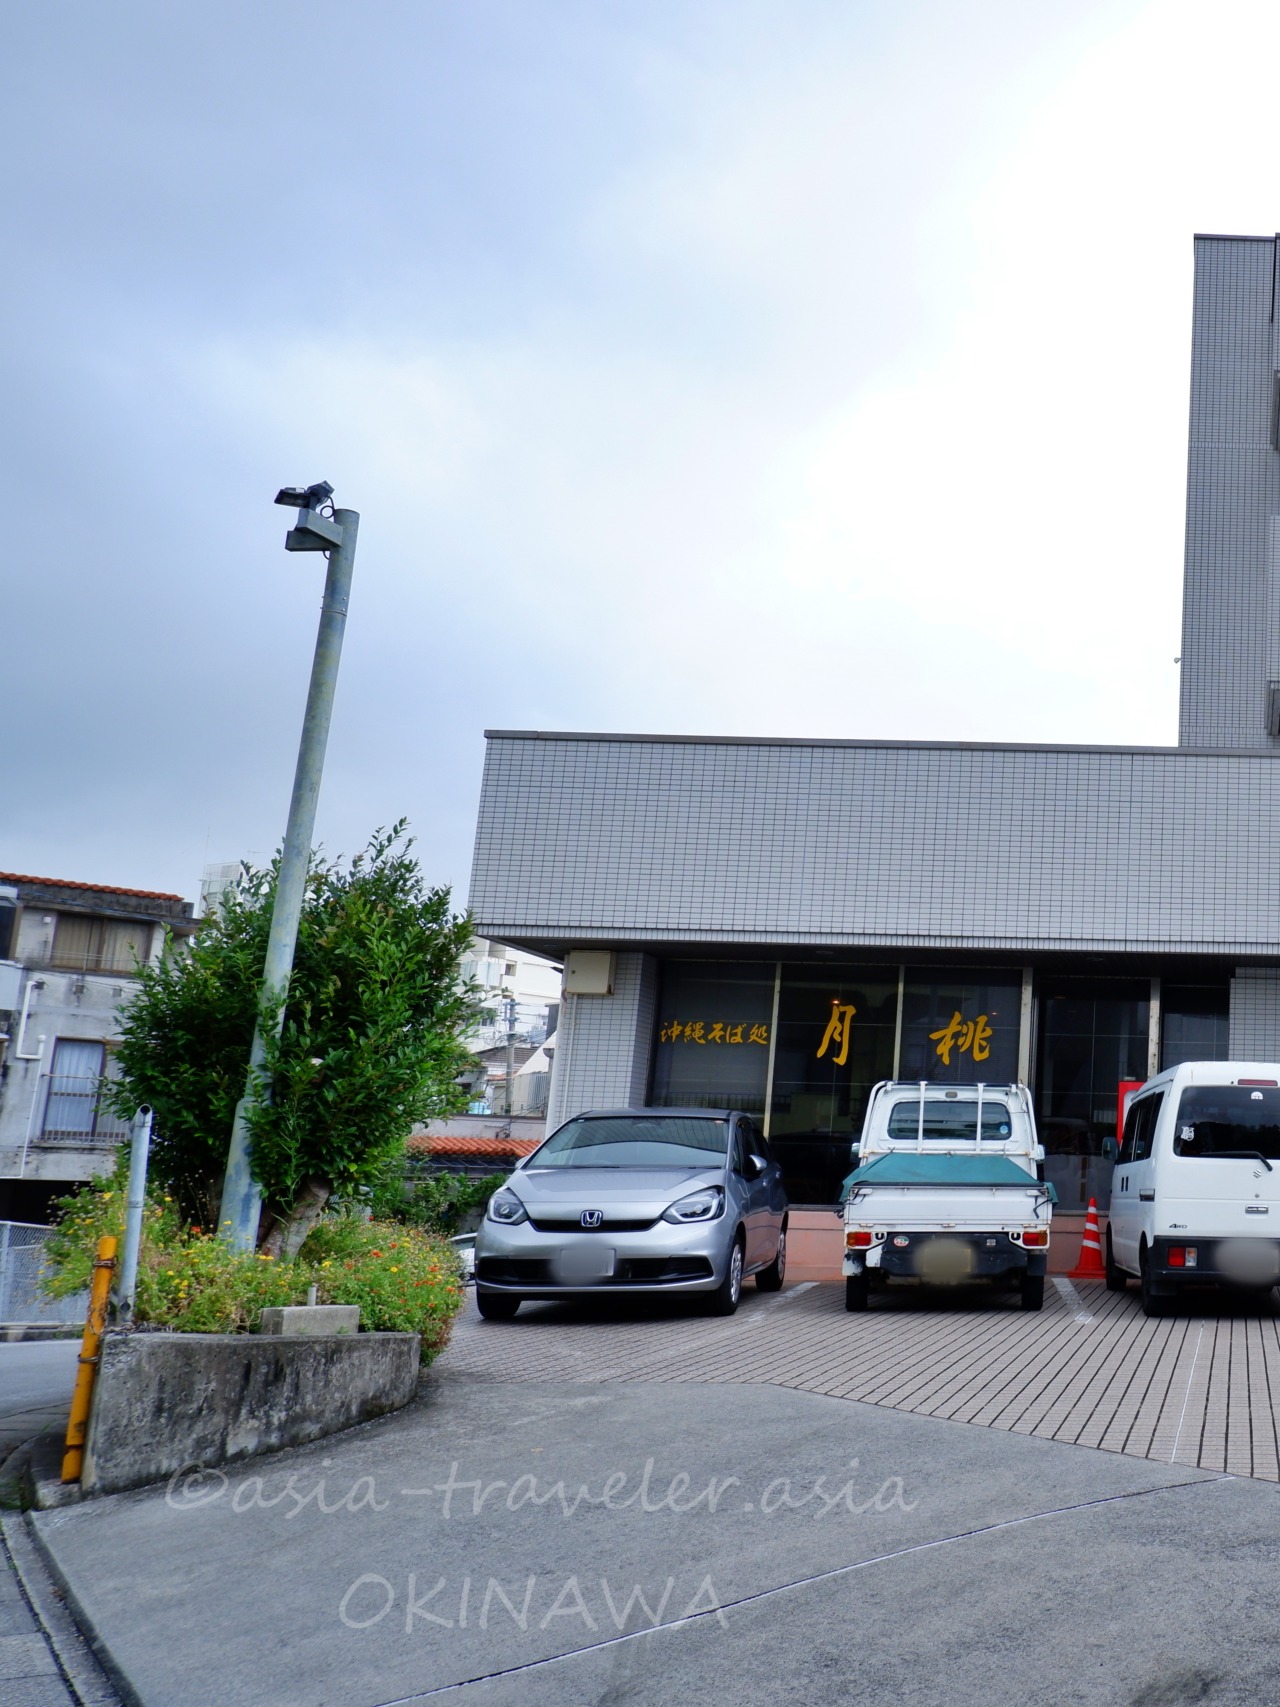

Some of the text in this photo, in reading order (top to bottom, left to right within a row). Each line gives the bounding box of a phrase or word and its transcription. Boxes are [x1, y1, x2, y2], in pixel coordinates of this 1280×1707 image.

[660, 1020, 769, 1045] 沖縄そば処
